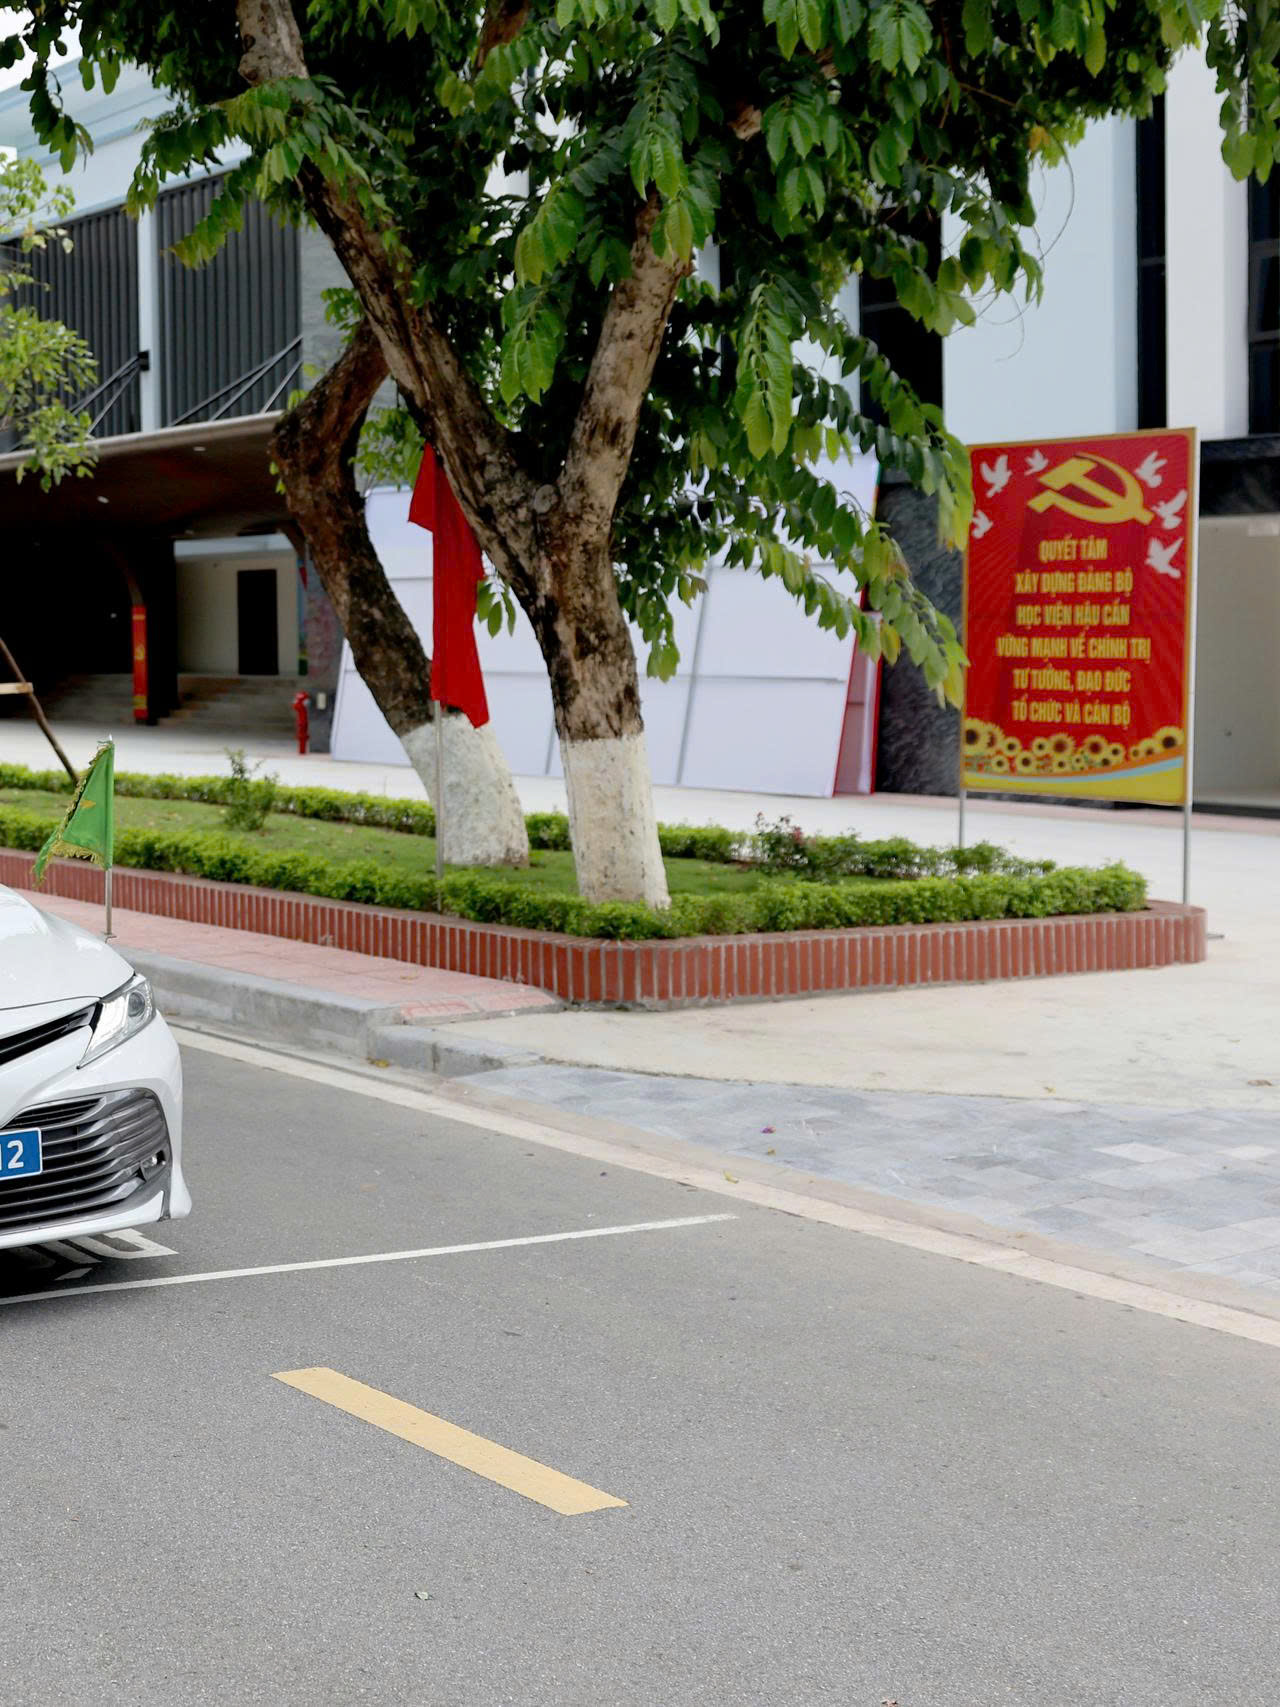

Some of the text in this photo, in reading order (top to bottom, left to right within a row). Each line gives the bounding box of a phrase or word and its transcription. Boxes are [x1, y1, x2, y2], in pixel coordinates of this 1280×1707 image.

[1039, 534, 1108, 563] QUYẾT TÂM
[1015, 566, 1133, 597] XÂY DỰNG ĐẢNG BỘ
[1016, 604, 1041, 630] HỌC
[1043, 601, 1072, 630] VIỆN
[1073, 601, 1100, 630] HẬU
[996, 633, 1029, 658] VỮNG
[1030, 637, 1068, 662] MẠNH
[1087, 634, 1128, 659] CHÍNH
[1129, 637, 1151, 664] TRỊ
[1013, 667, 1030, 689] TƯ
[1075, 670, 1102, 696] ĐẠO
[1104, 667, 1131, 692] ĐỨC
[1012, 694, 1131, 730] TỔ CHỨC VÀ CÁN BỘ
